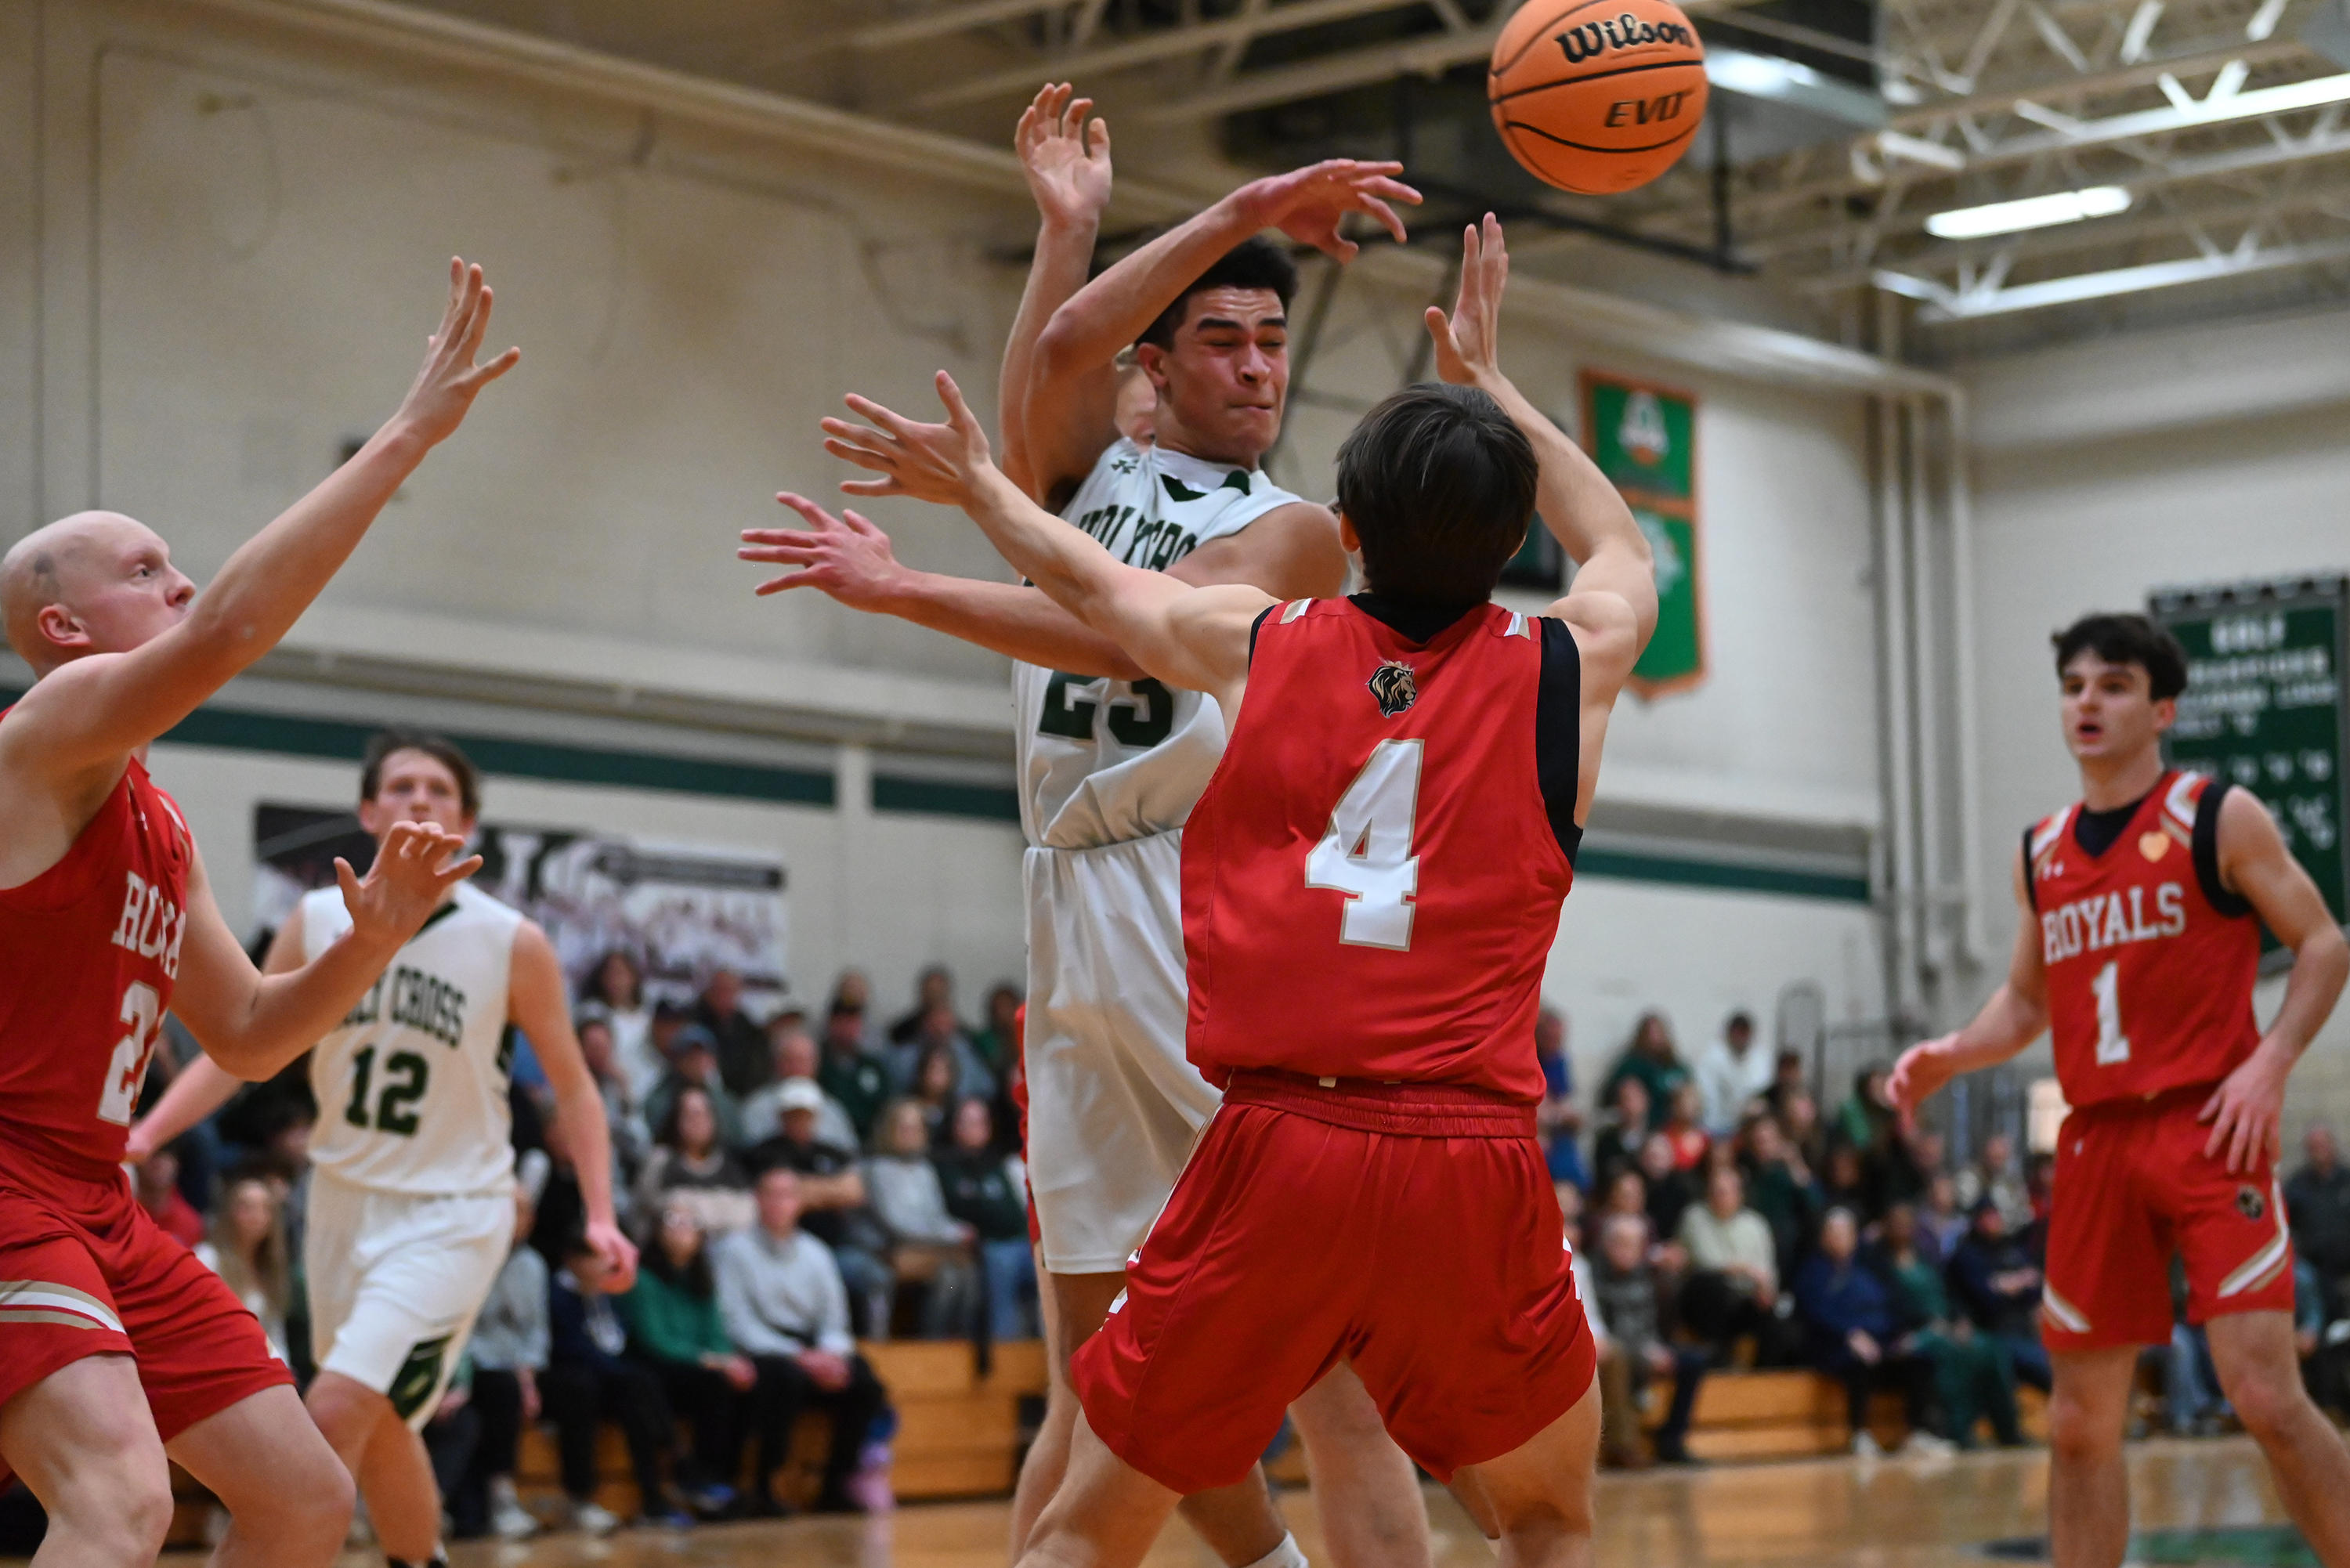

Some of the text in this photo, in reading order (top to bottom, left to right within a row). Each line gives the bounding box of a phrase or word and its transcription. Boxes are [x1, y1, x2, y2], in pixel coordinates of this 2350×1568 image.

[1555, 13, 1694, 63] Wilson
[1305, 739, 1425, 952] 4
[2042, 881, 2186, 966] ROYALS
[93, 980, 168, 1126] 2
[391, 966, 465, 1050] CROSS
[2092, 960, 2131, 1067] 1
[345, 1043, 430, 1138] 12
